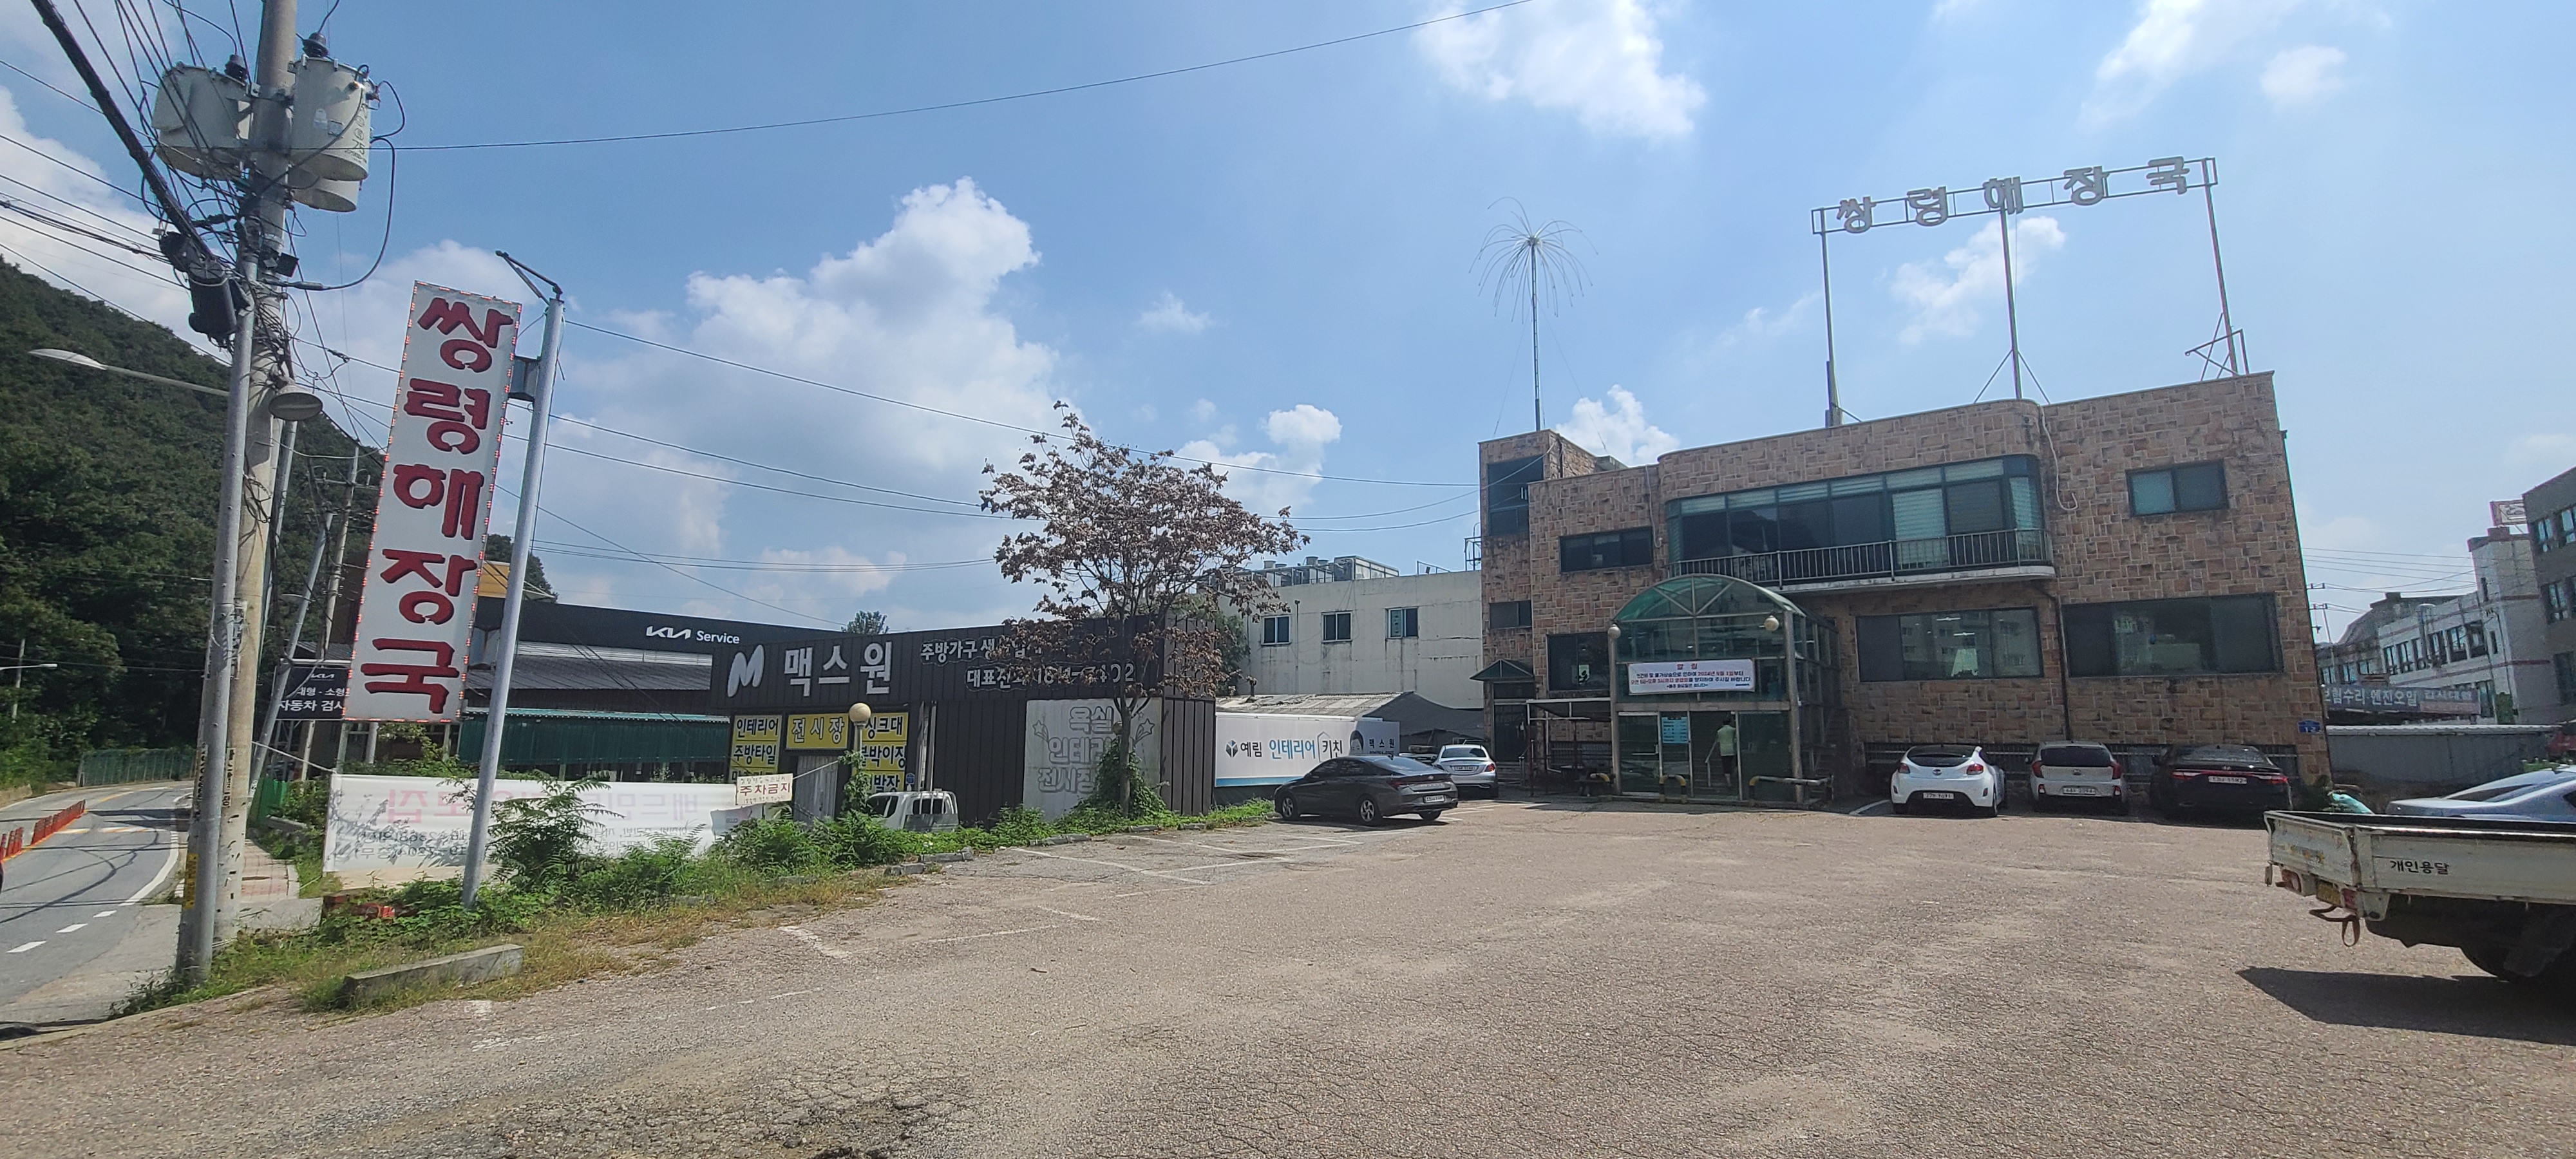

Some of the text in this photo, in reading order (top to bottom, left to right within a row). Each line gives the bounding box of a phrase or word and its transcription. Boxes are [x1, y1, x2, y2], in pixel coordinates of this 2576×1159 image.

[1836, 156, 2190, 234] 쌍령해장국
[360, 296, 514, 715] 쌍령해장국
[646, 625, 740, 645] KIA Service
[920, 640, 978, 663] 주방가구
[784, 641, 893, 697] 맥스원
[325, 687, 345, 697] 소형
[736, 718, 779, 739] 인테리어
[791, 716, 844, 744] 전시장
[864, 715, 903, 739] 싱크대
[1069, 706, 1113, 734] 욕실
[733, 744, 777, 765] 주방타일
[1240, 739, 1343, 760] 예림 인테리어 키친
[739, 782, 790, 796] 주차금지
[2390, 860, 2450, 876] 개인용달
